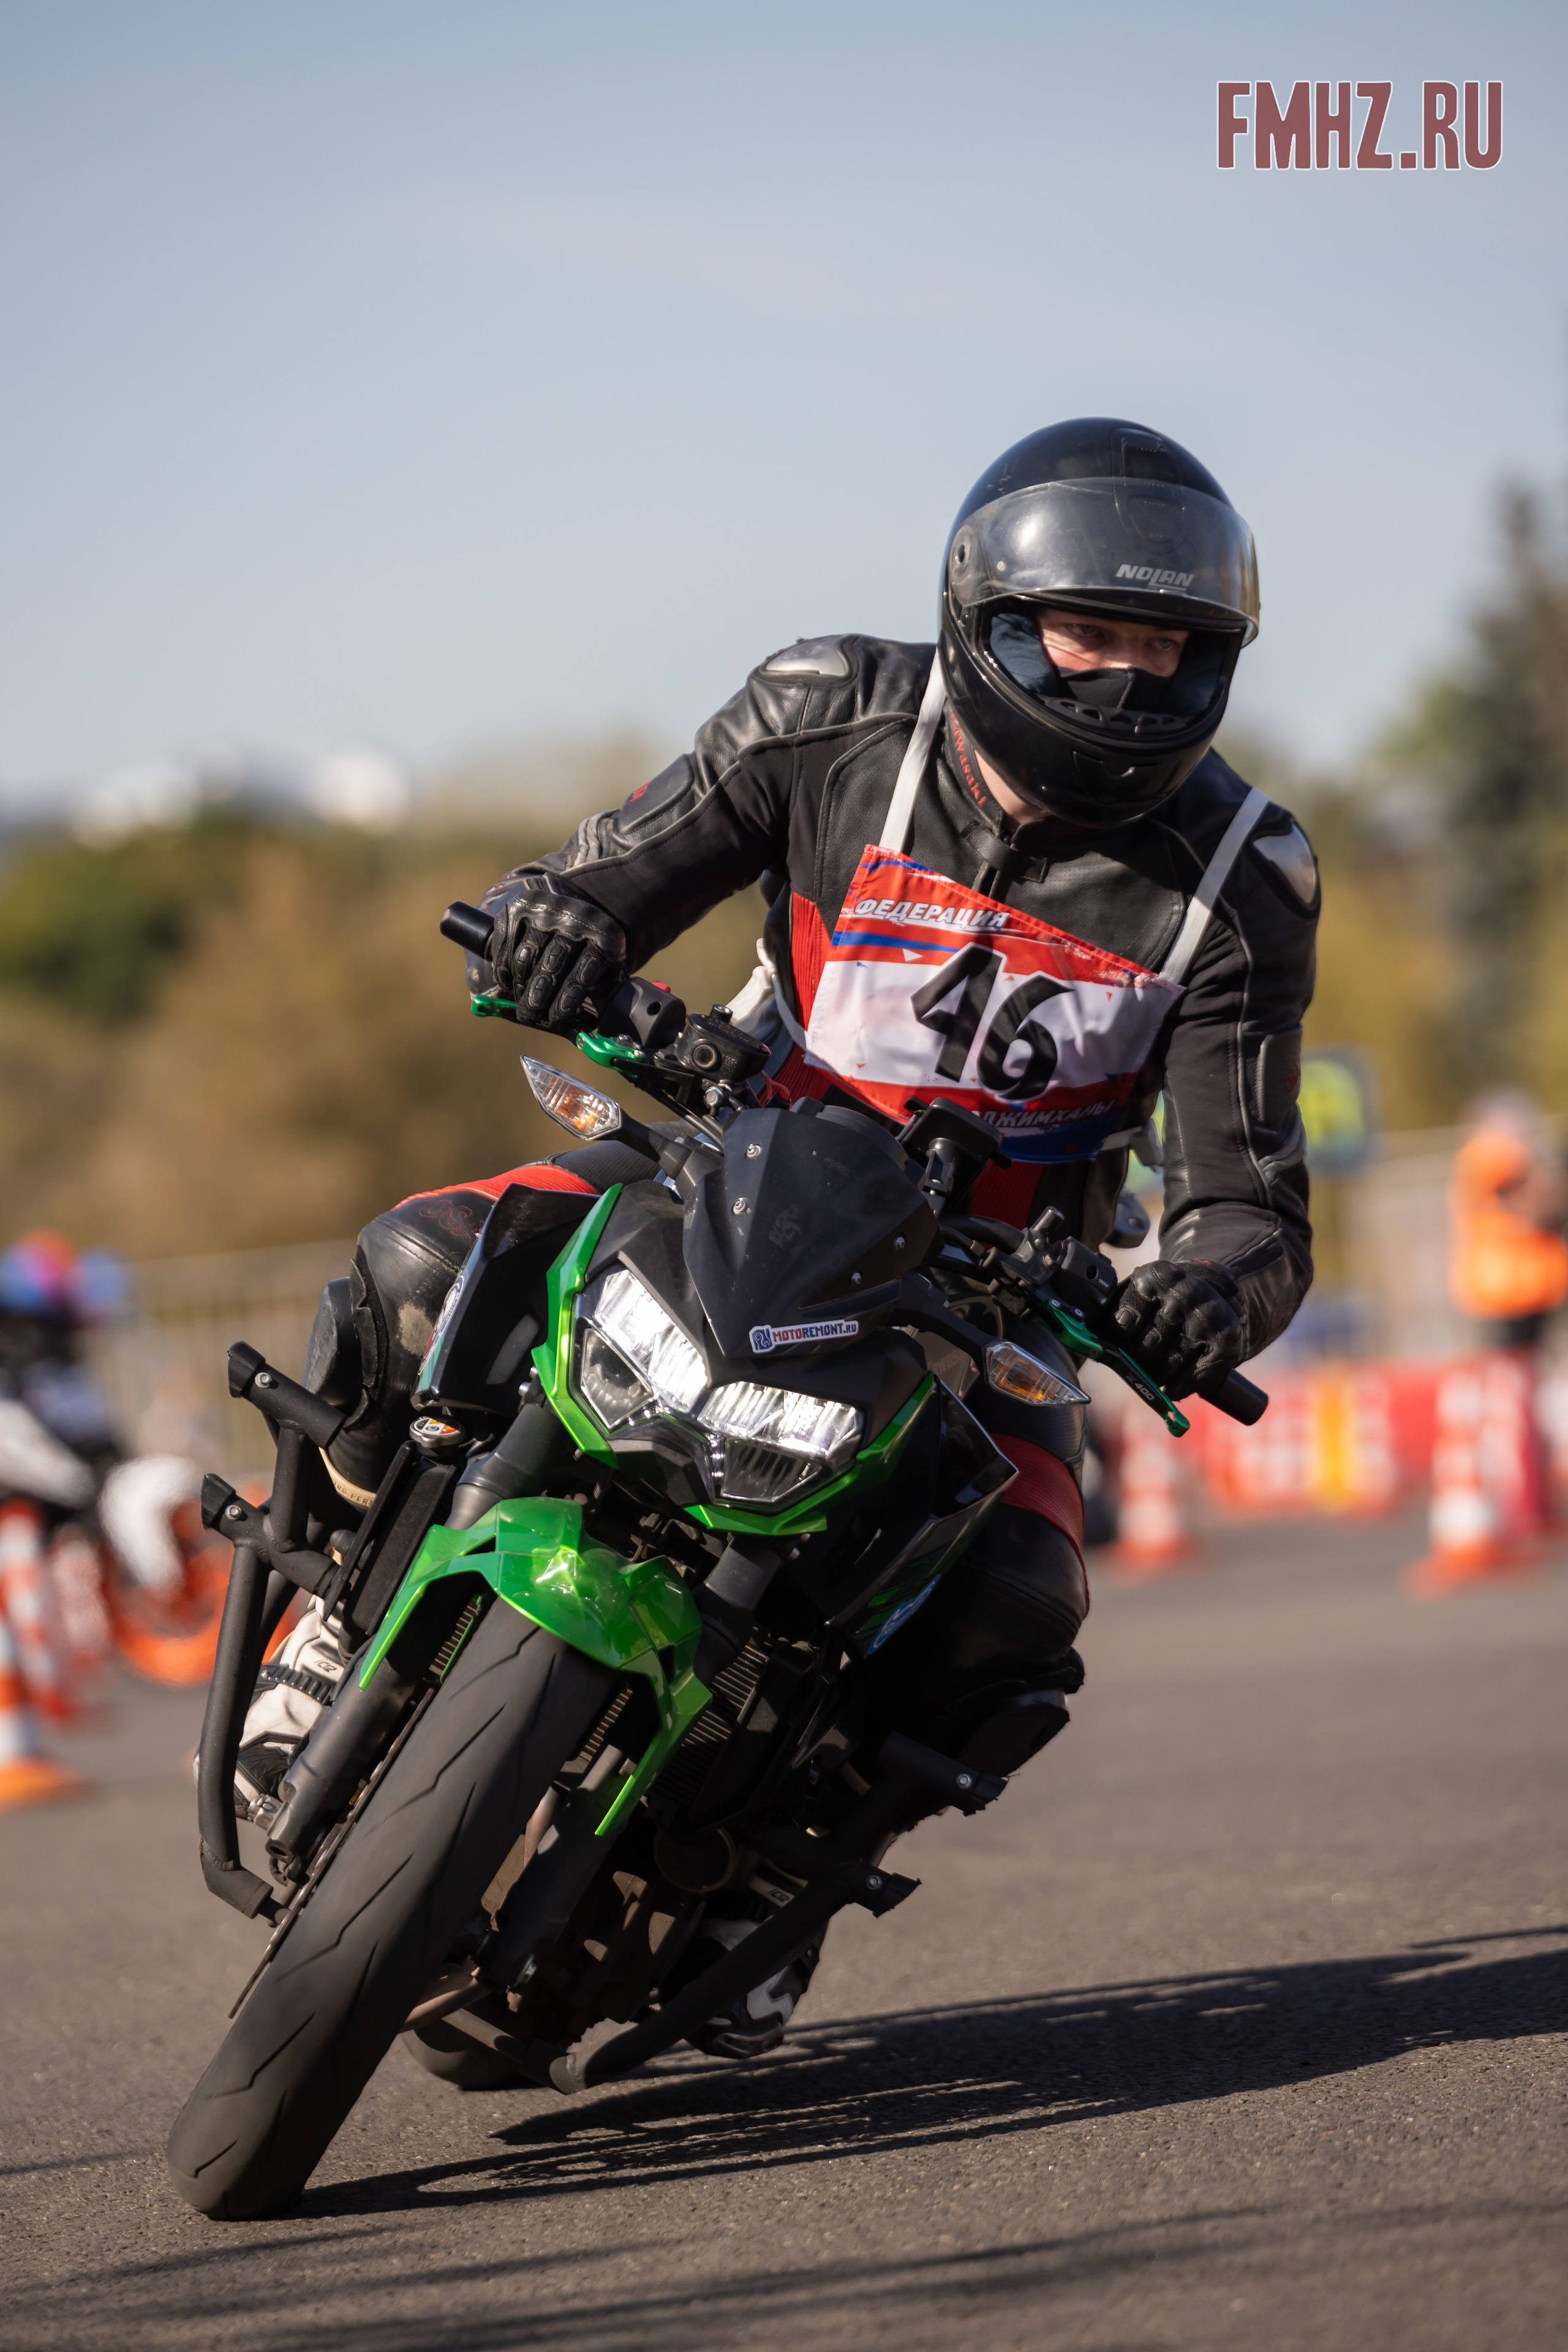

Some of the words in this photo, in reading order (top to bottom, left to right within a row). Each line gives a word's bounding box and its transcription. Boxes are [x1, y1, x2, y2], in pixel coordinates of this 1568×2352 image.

[1115, 564, 1194, 591] NOLAN
[855, 898, 1009, 929] ФЕДЕРАЦИЯ
[910, 941, 1075, 1101] 46
[972, 1100, 1115, 1127] ДЖИМХАНЫ
[772, 1322, 856, 1342] MOTOREMONT.RU
